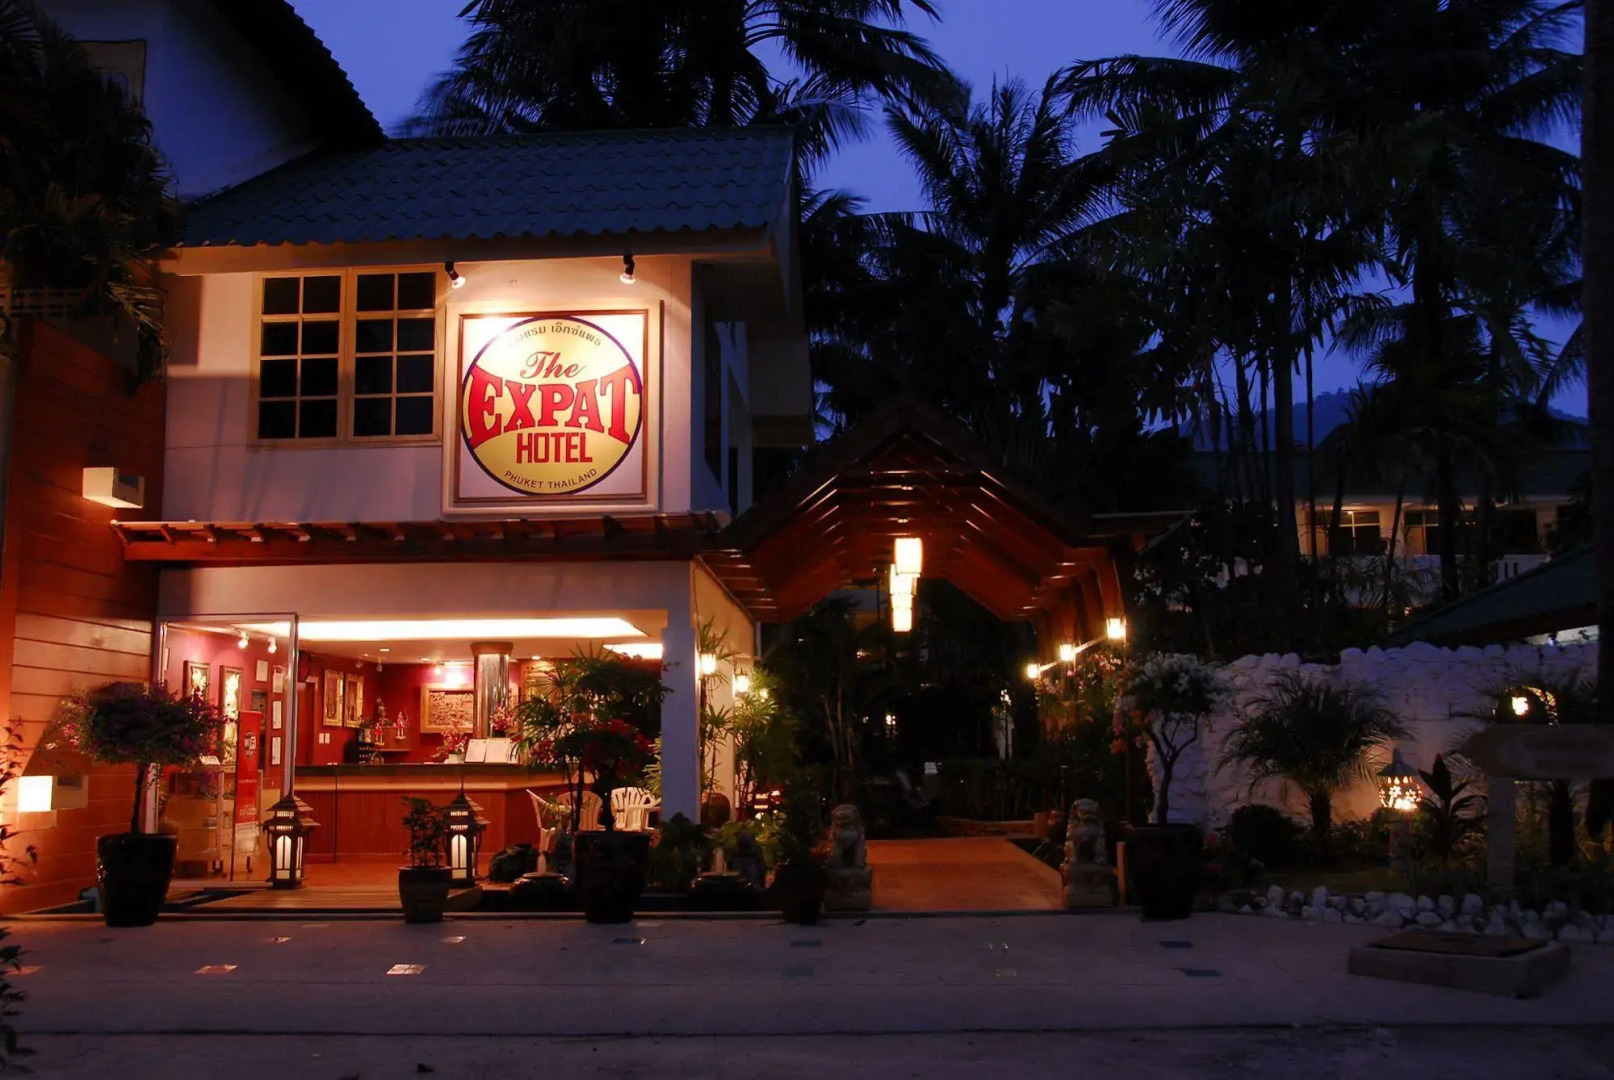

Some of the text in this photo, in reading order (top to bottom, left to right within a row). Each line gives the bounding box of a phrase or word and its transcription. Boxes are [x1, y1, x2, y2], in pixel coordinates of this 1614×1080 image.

[520, 351, 586, 378] The
[468, 364, 639, 450] EXPAT
[516, 432, 593, 464] HOTEL
[504, 468, 598, 489] PHUKET THAILAND
